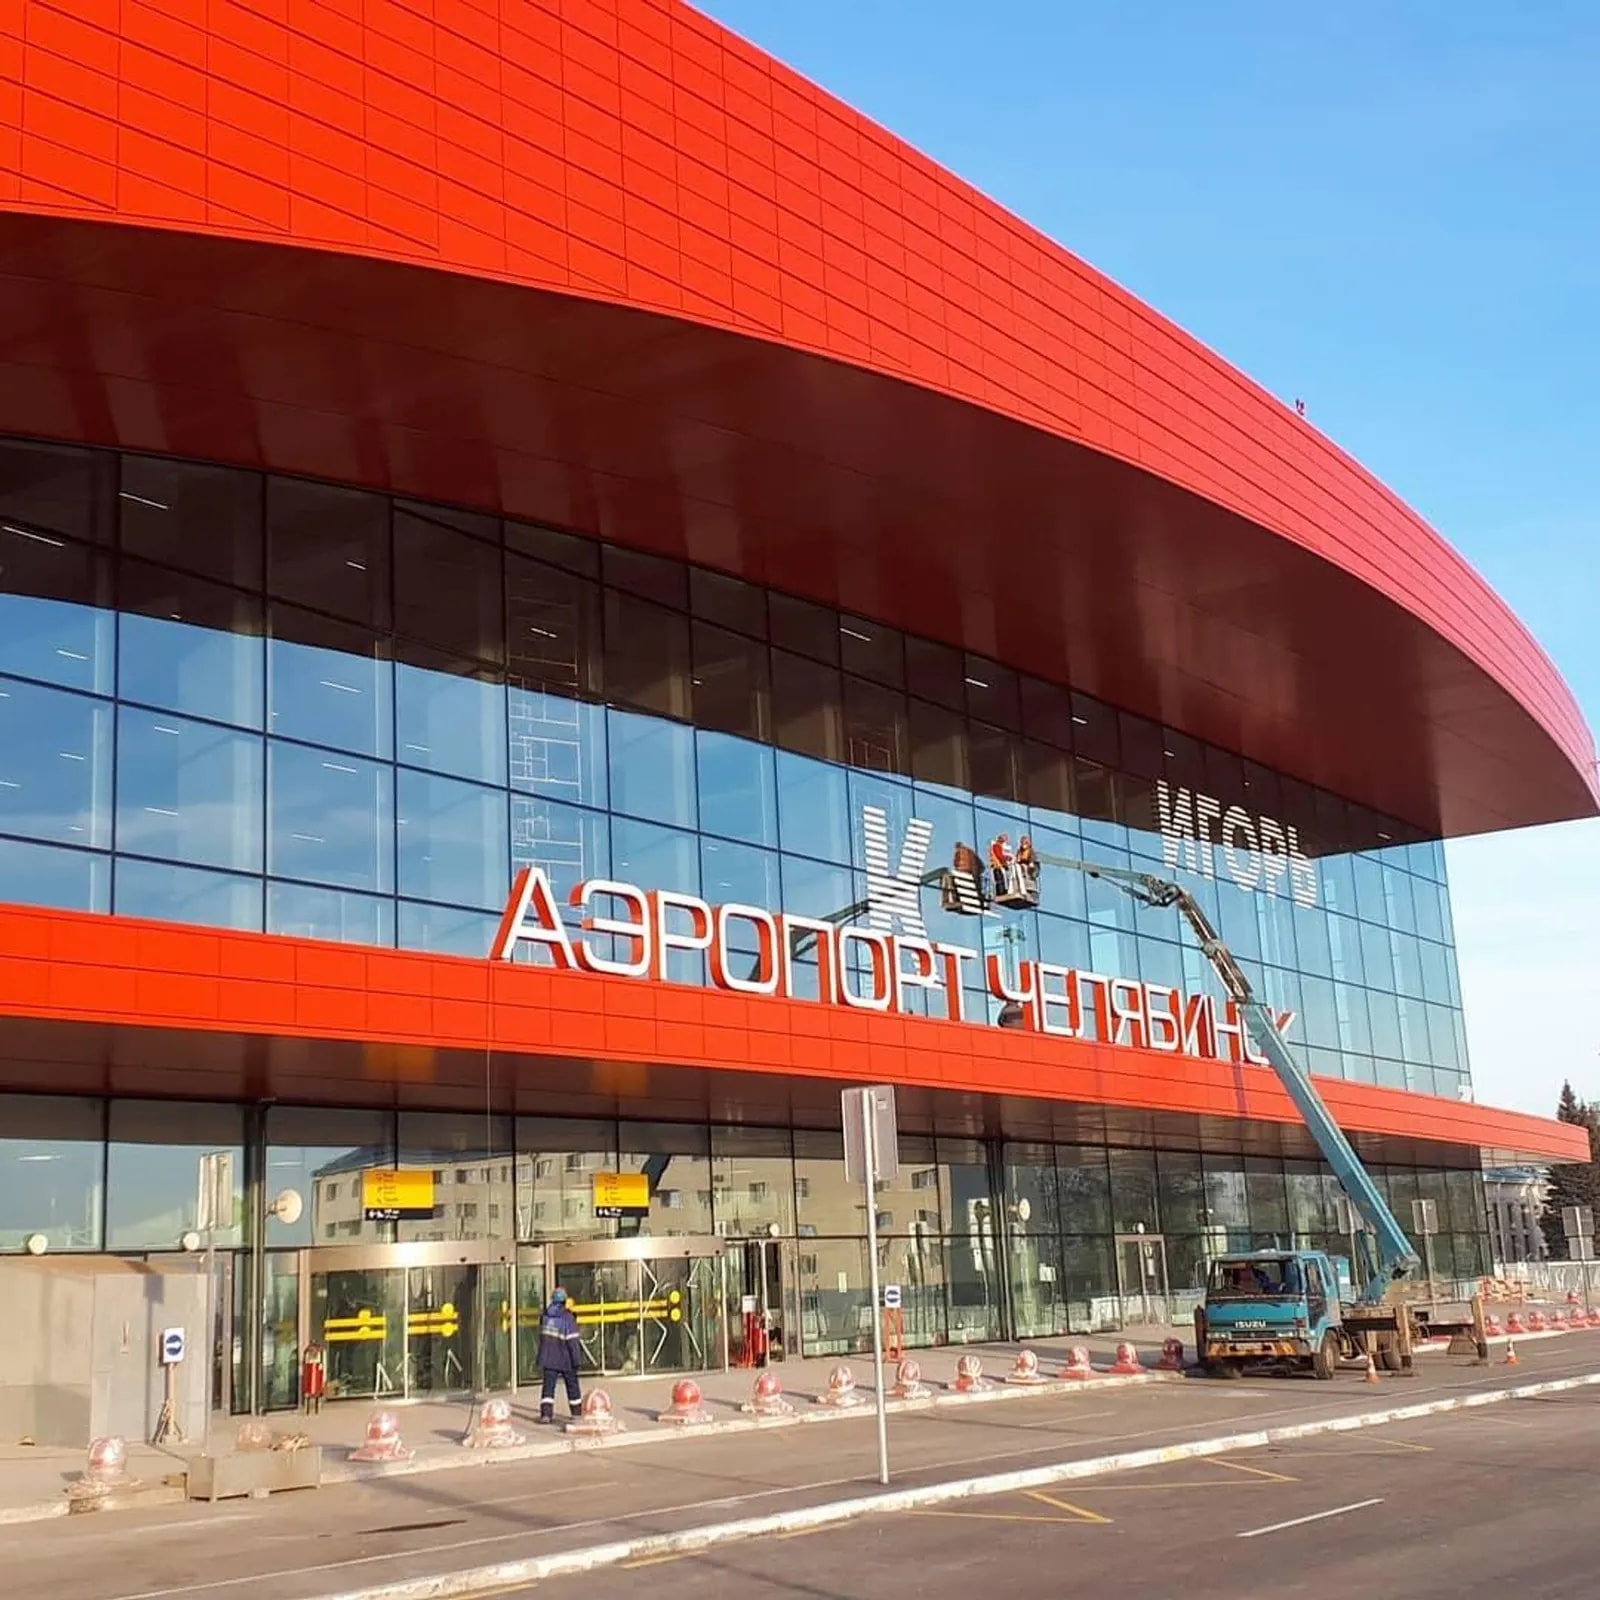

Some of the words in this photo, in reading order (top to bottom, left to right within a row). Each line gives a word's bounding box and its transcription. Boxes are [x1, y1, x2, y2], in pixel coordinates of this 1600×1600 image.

[1156, 779, 1317, 909] ИГОРЬ
[490, 867, 977, 1022] АЭРОПОРТ
[1234, 1319, 1266, 1329] ISUZU
